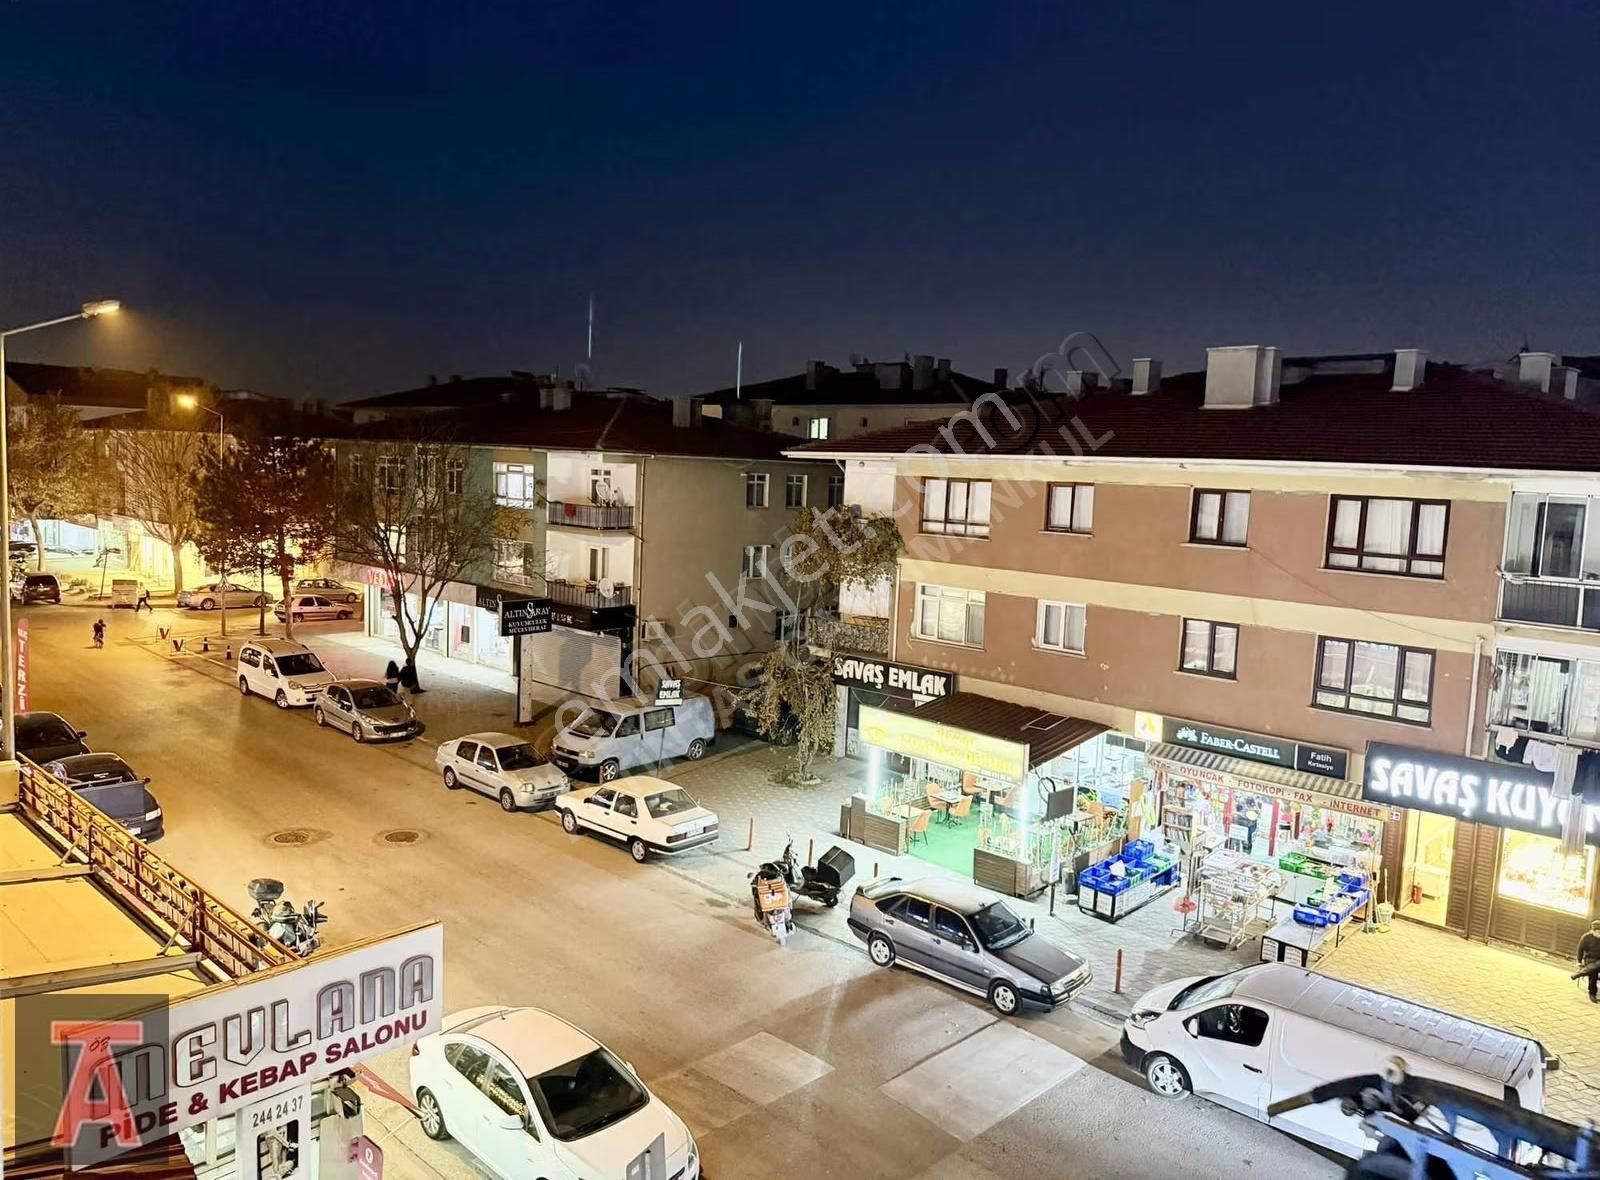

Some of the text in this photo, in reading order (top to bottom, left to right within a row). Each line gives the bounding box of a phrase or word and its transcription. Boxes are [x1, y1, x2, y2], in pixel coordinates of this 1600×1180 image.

[834, 657, 947, 696] SAVAŞ EMLAK
[1200, 732, 1281, 760] FABER-CASTELL
[1294, 792, 1314, 803] FAX
[1370, 757, 1482, 818] SAVAŞ
[100, 1010, 427, 1148] PİDE & KEBAP SALONU
[252, 1095, 304, 1128] 244 24 37
